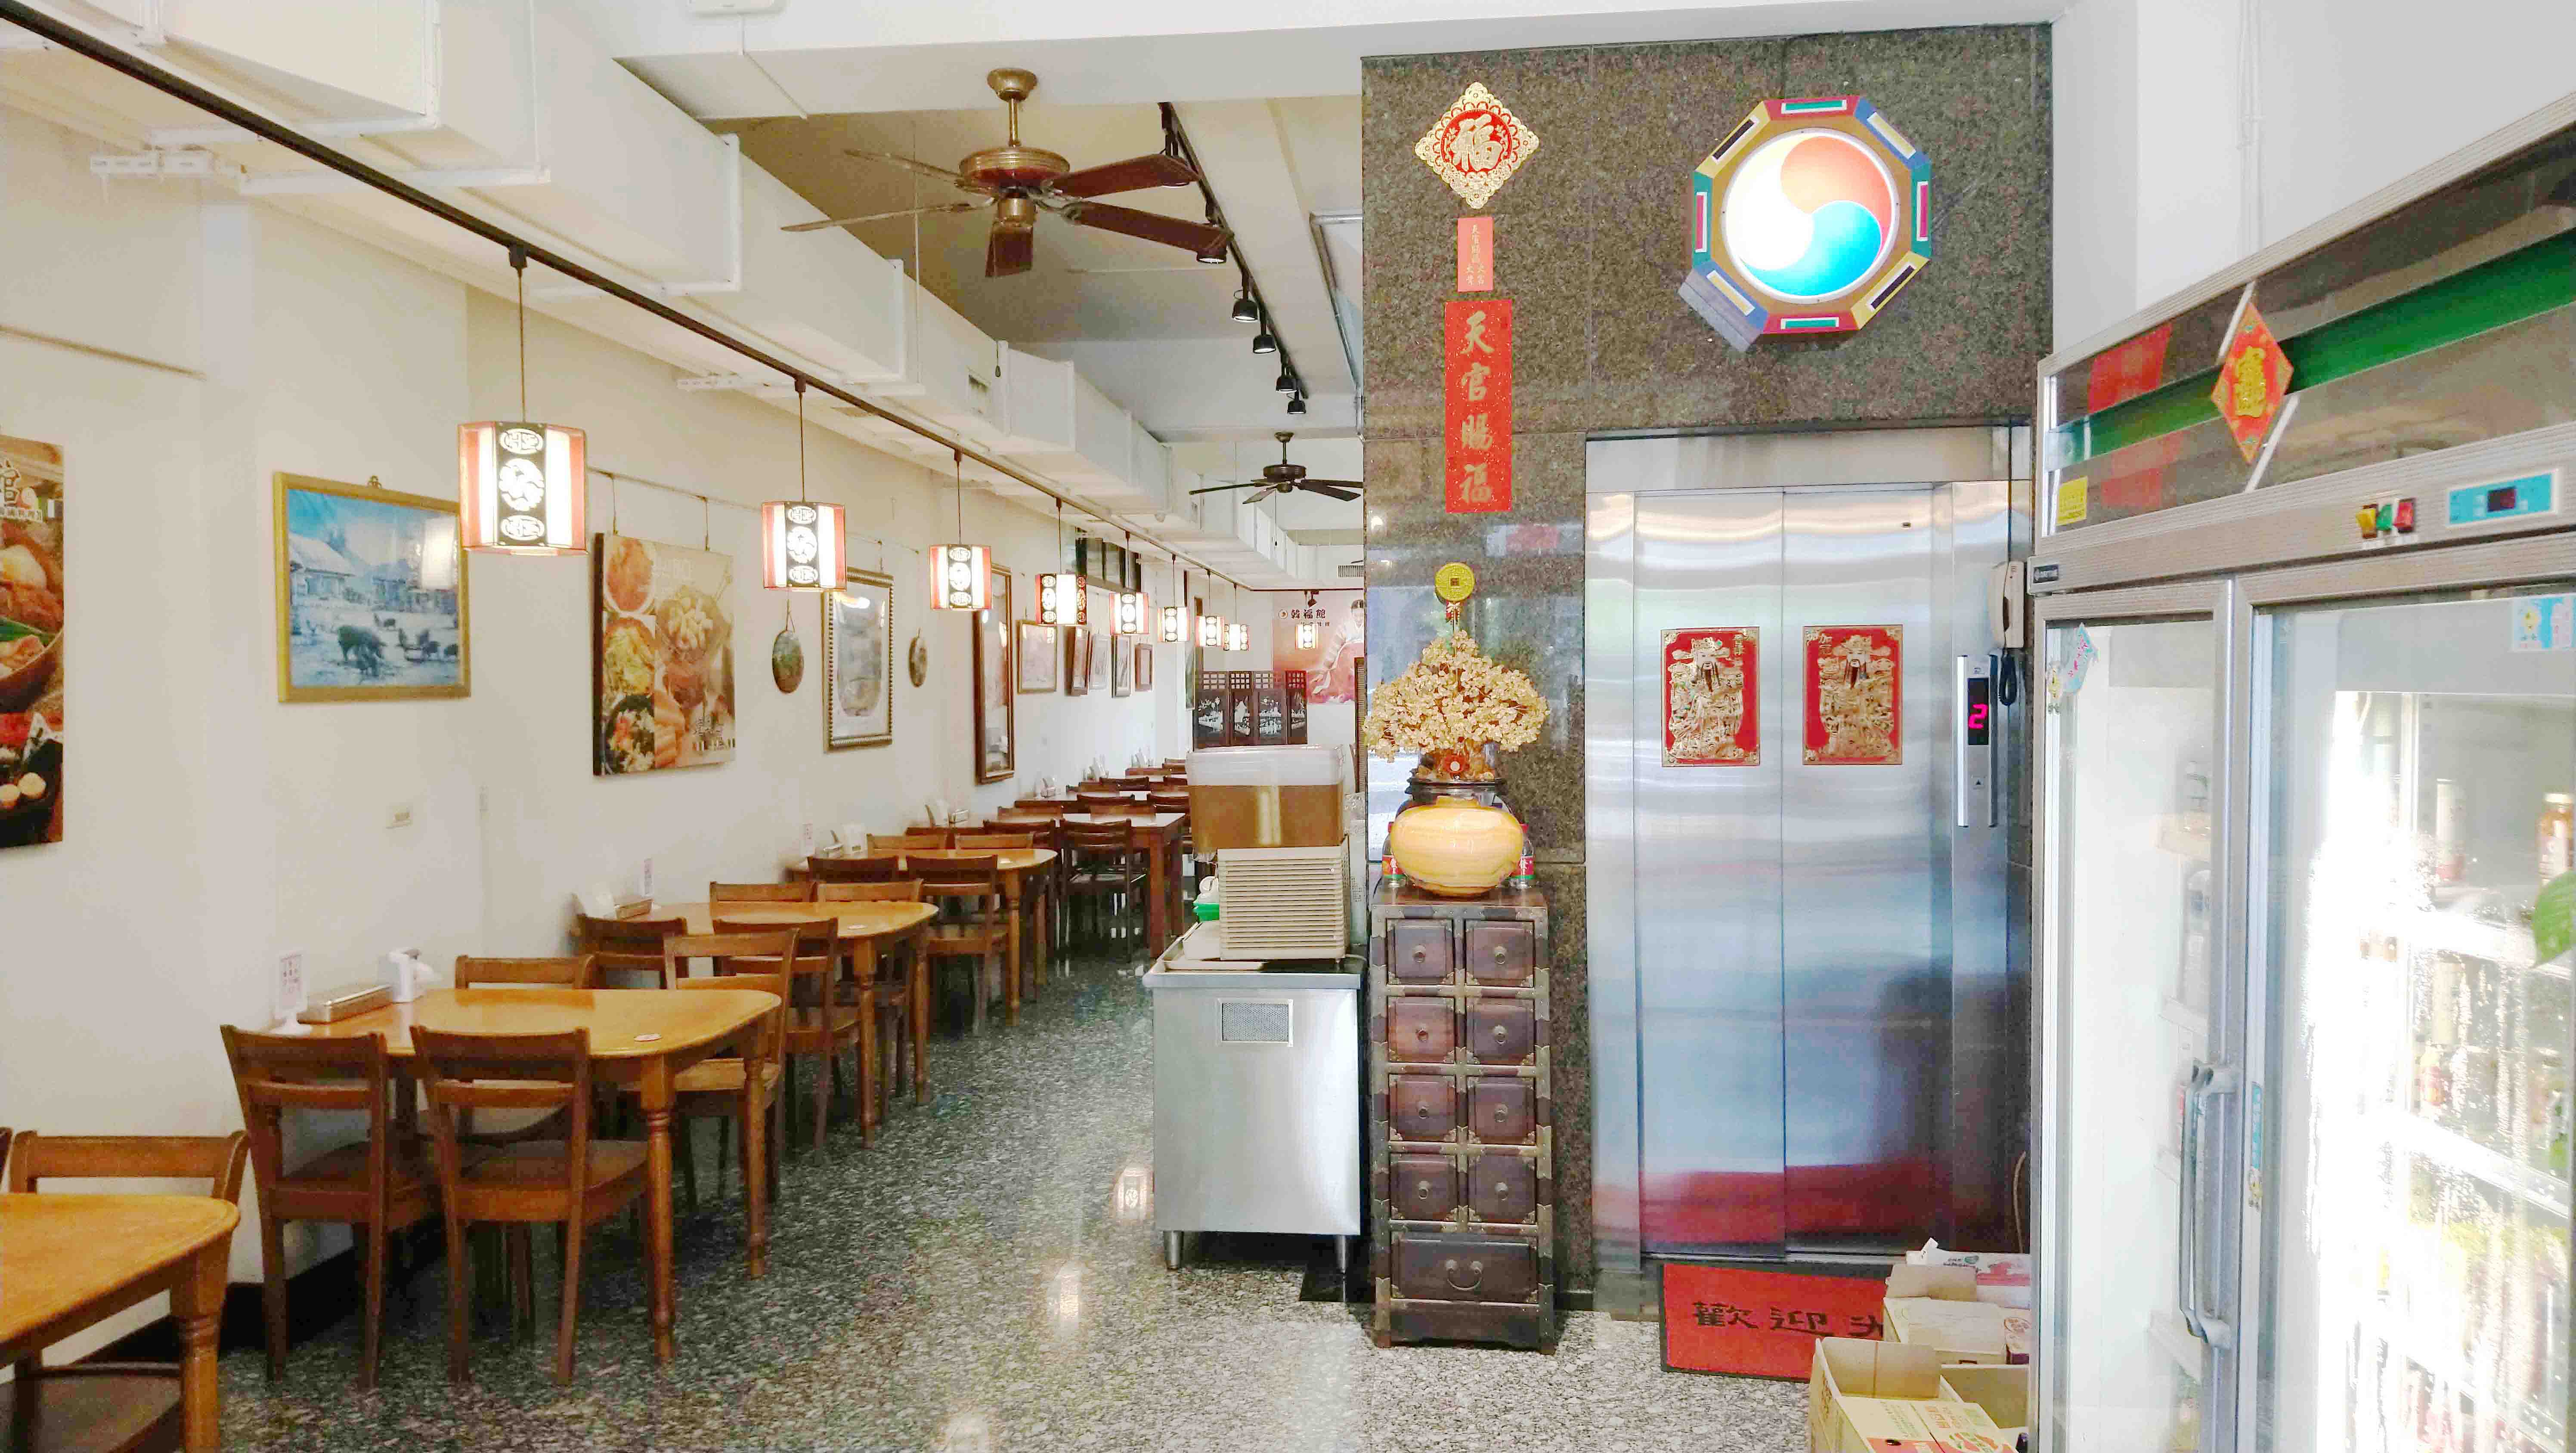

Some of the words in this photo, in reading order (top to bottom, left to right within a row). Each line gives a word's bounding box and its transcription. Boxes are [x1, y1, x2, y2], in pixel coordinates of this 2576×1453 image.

[1450, 114, 1503, 171] 福
[1460, 310, 1495, 503] 天官賜福
[1291, 609, 1326, 619] 韓福館
[1968, 703, 1989, 730] 2
